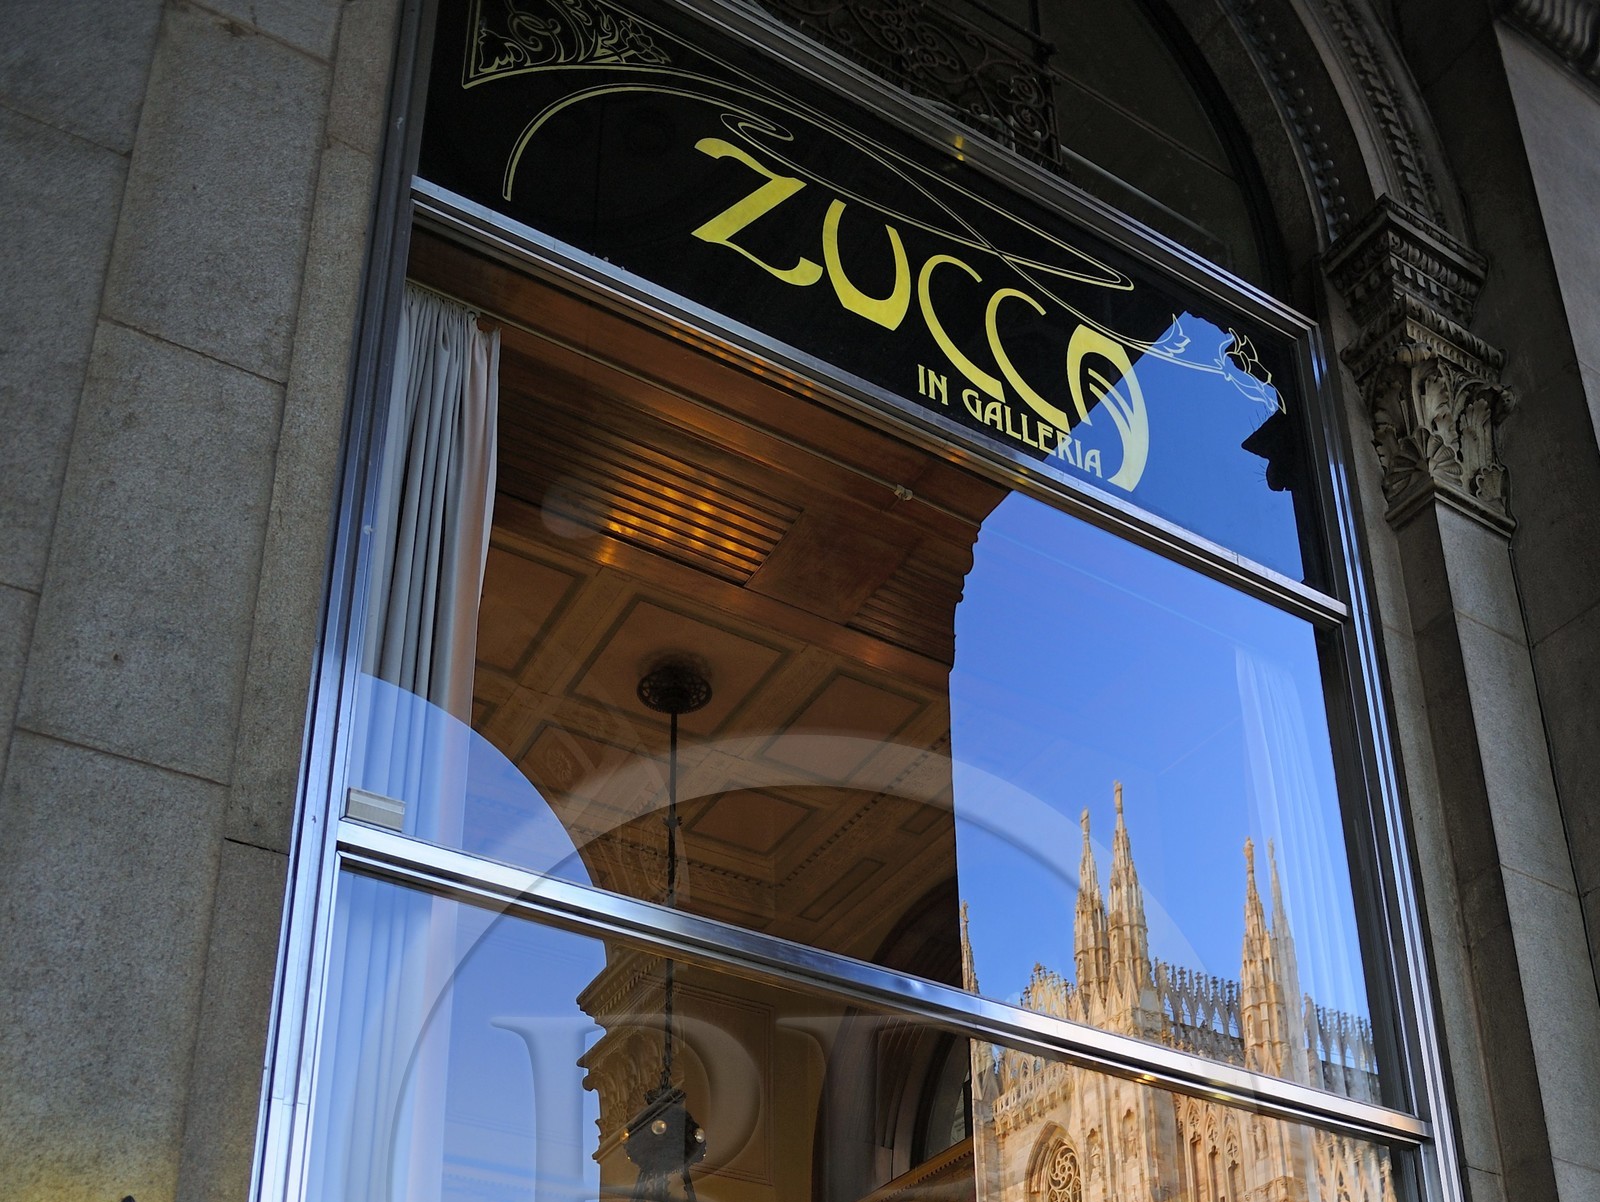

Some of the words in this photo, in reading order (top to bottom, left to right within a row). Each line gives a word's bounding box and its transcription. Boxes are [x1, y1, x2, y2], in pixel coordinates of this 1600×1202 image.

[691, 137, 1150, 492] ZUCCA
[918, 364, 948, 406] IN
[963, 388, 1103, 479] GALLERIA
